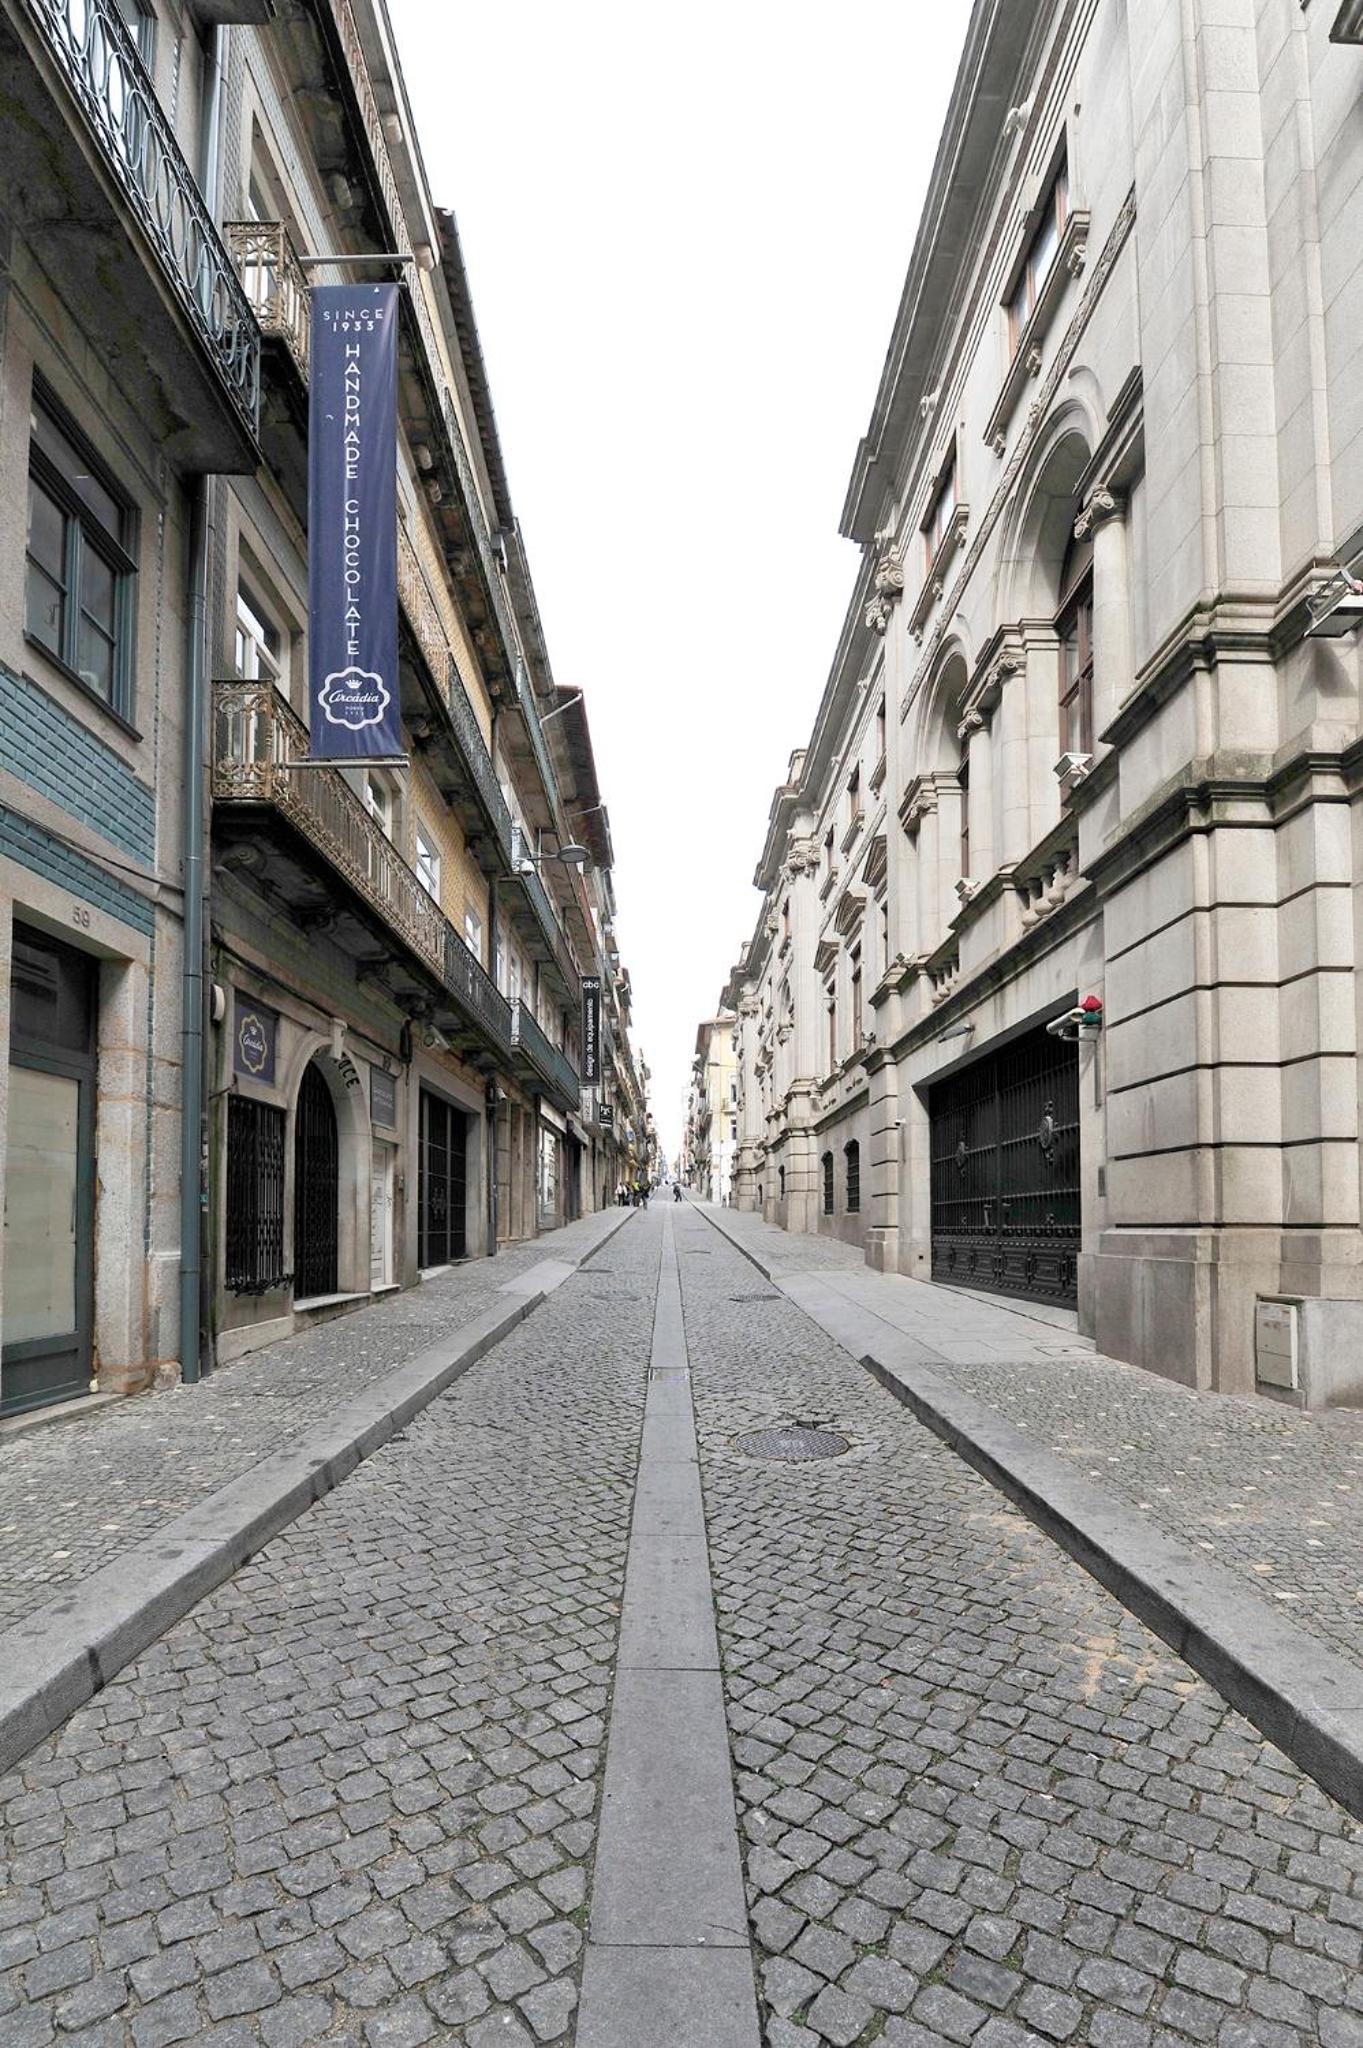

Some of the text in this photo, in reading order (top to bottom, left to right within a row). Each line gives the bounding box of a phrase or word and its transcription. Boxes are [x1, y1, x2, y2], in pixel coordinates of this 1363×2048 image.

[322, 308, 384, 321] SINCE
[333, 320, 374, 332] 1933
[344, 343, 361, 655] HANDMADE CHOCOLATE
